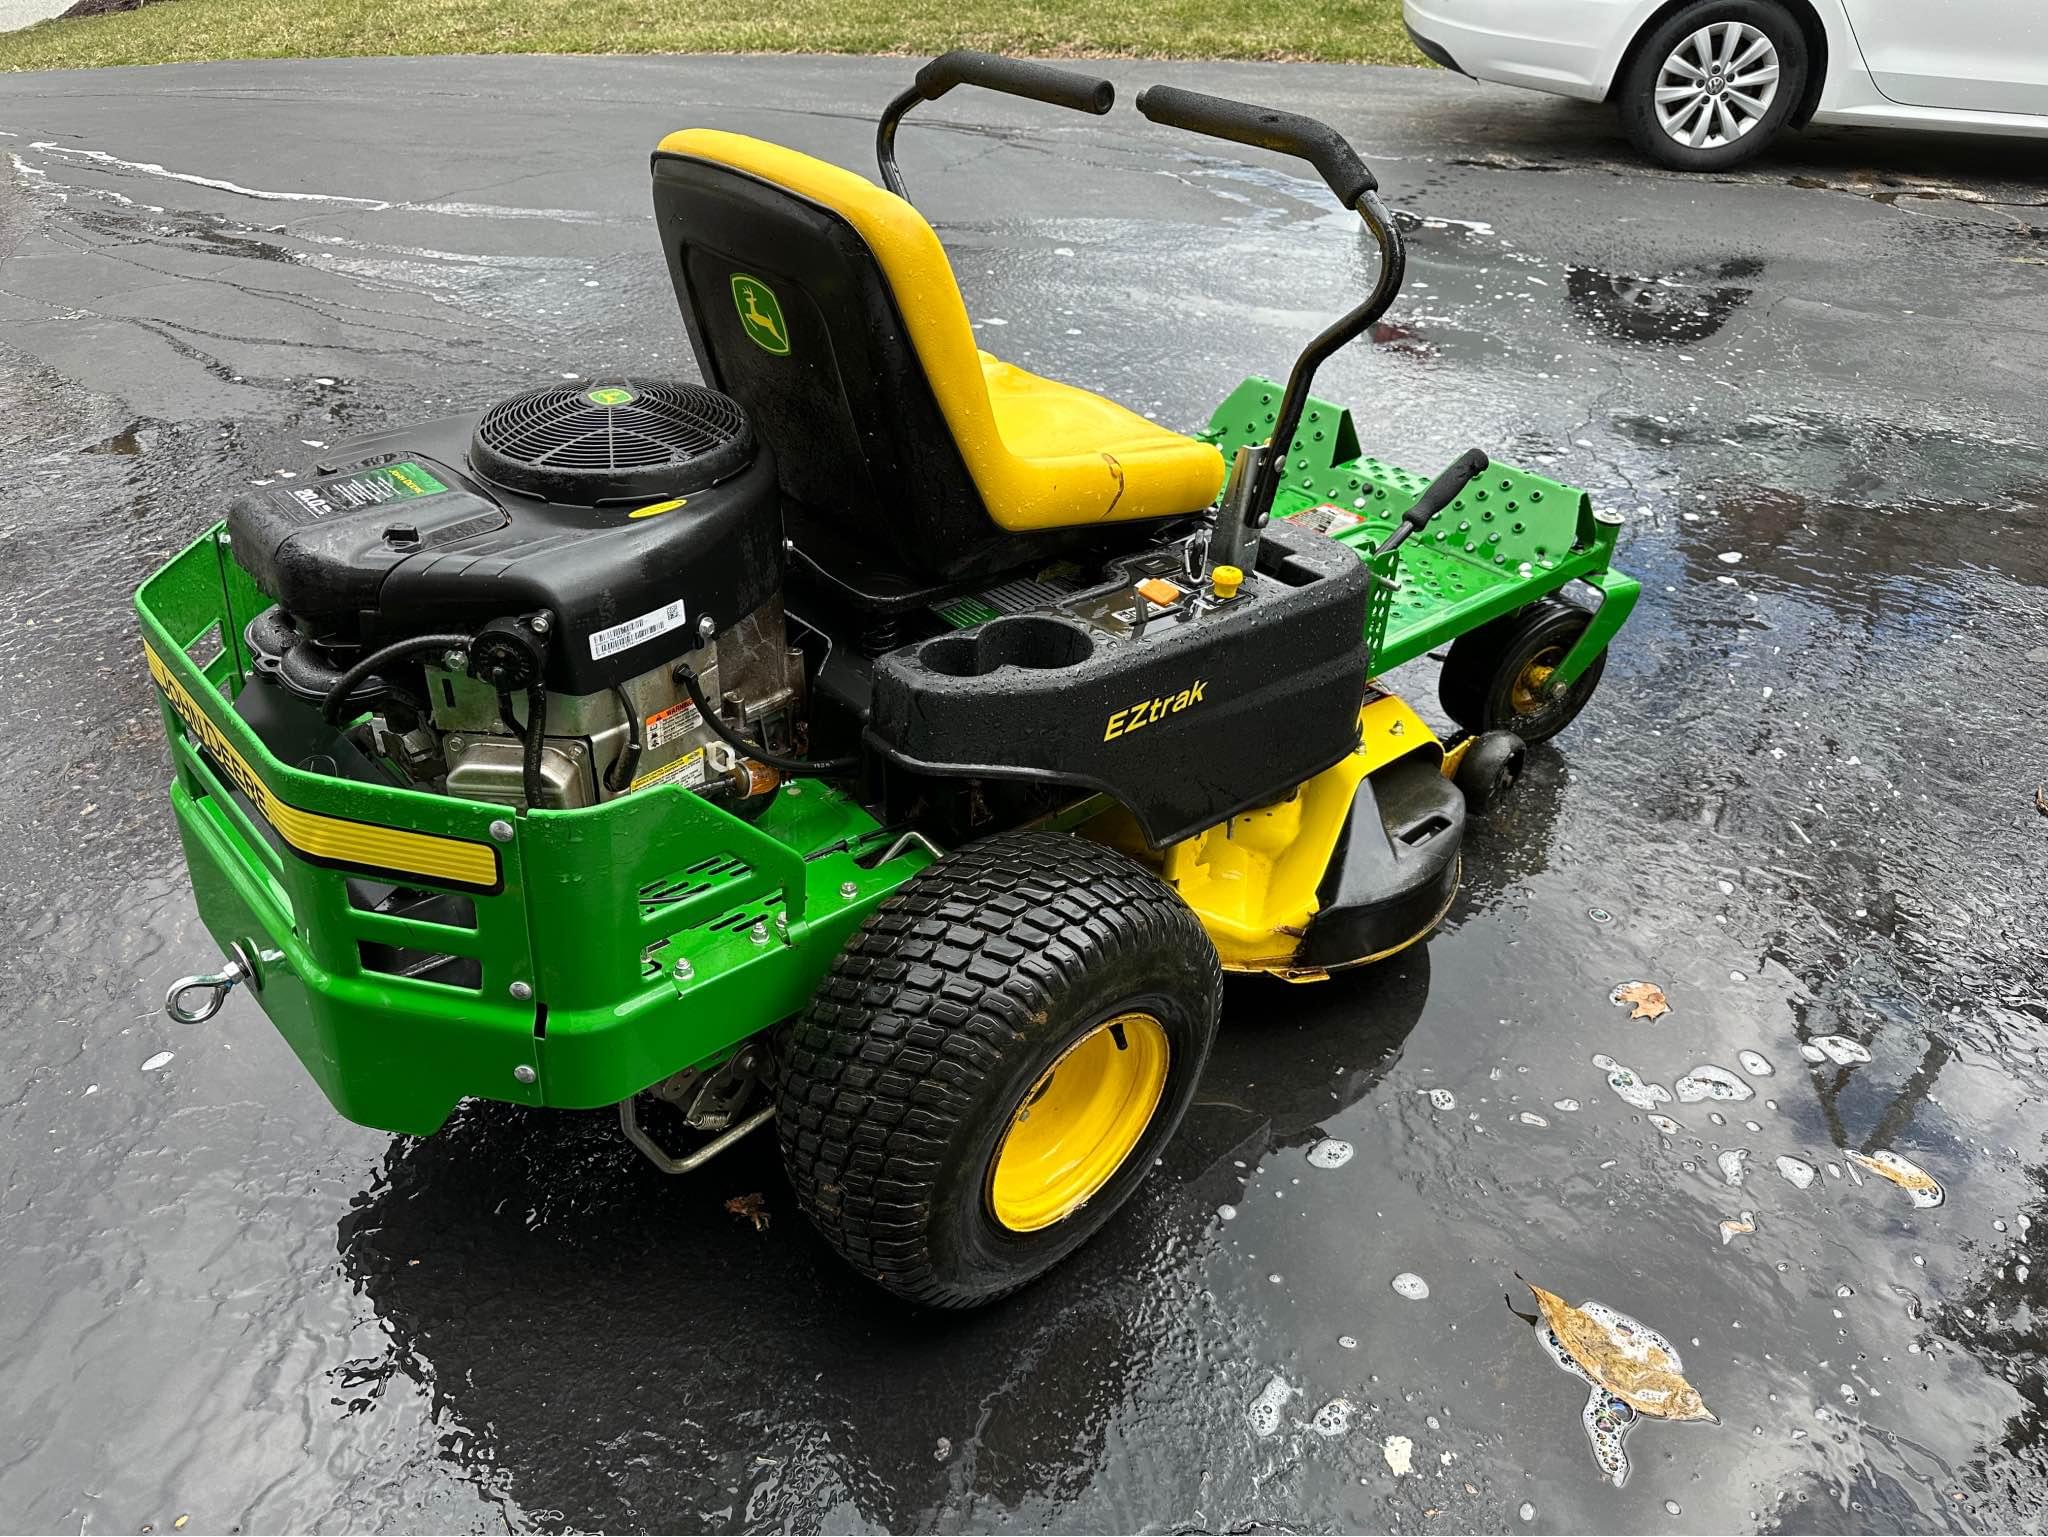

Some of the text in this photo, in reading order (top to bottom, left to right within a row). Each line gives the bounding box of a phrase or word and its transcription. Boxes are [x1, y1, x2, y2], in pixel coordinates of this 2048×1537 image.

[161, 666, 270, 819] JOHN DEERE
[1103, 679, 1209, 742] EZtrak
